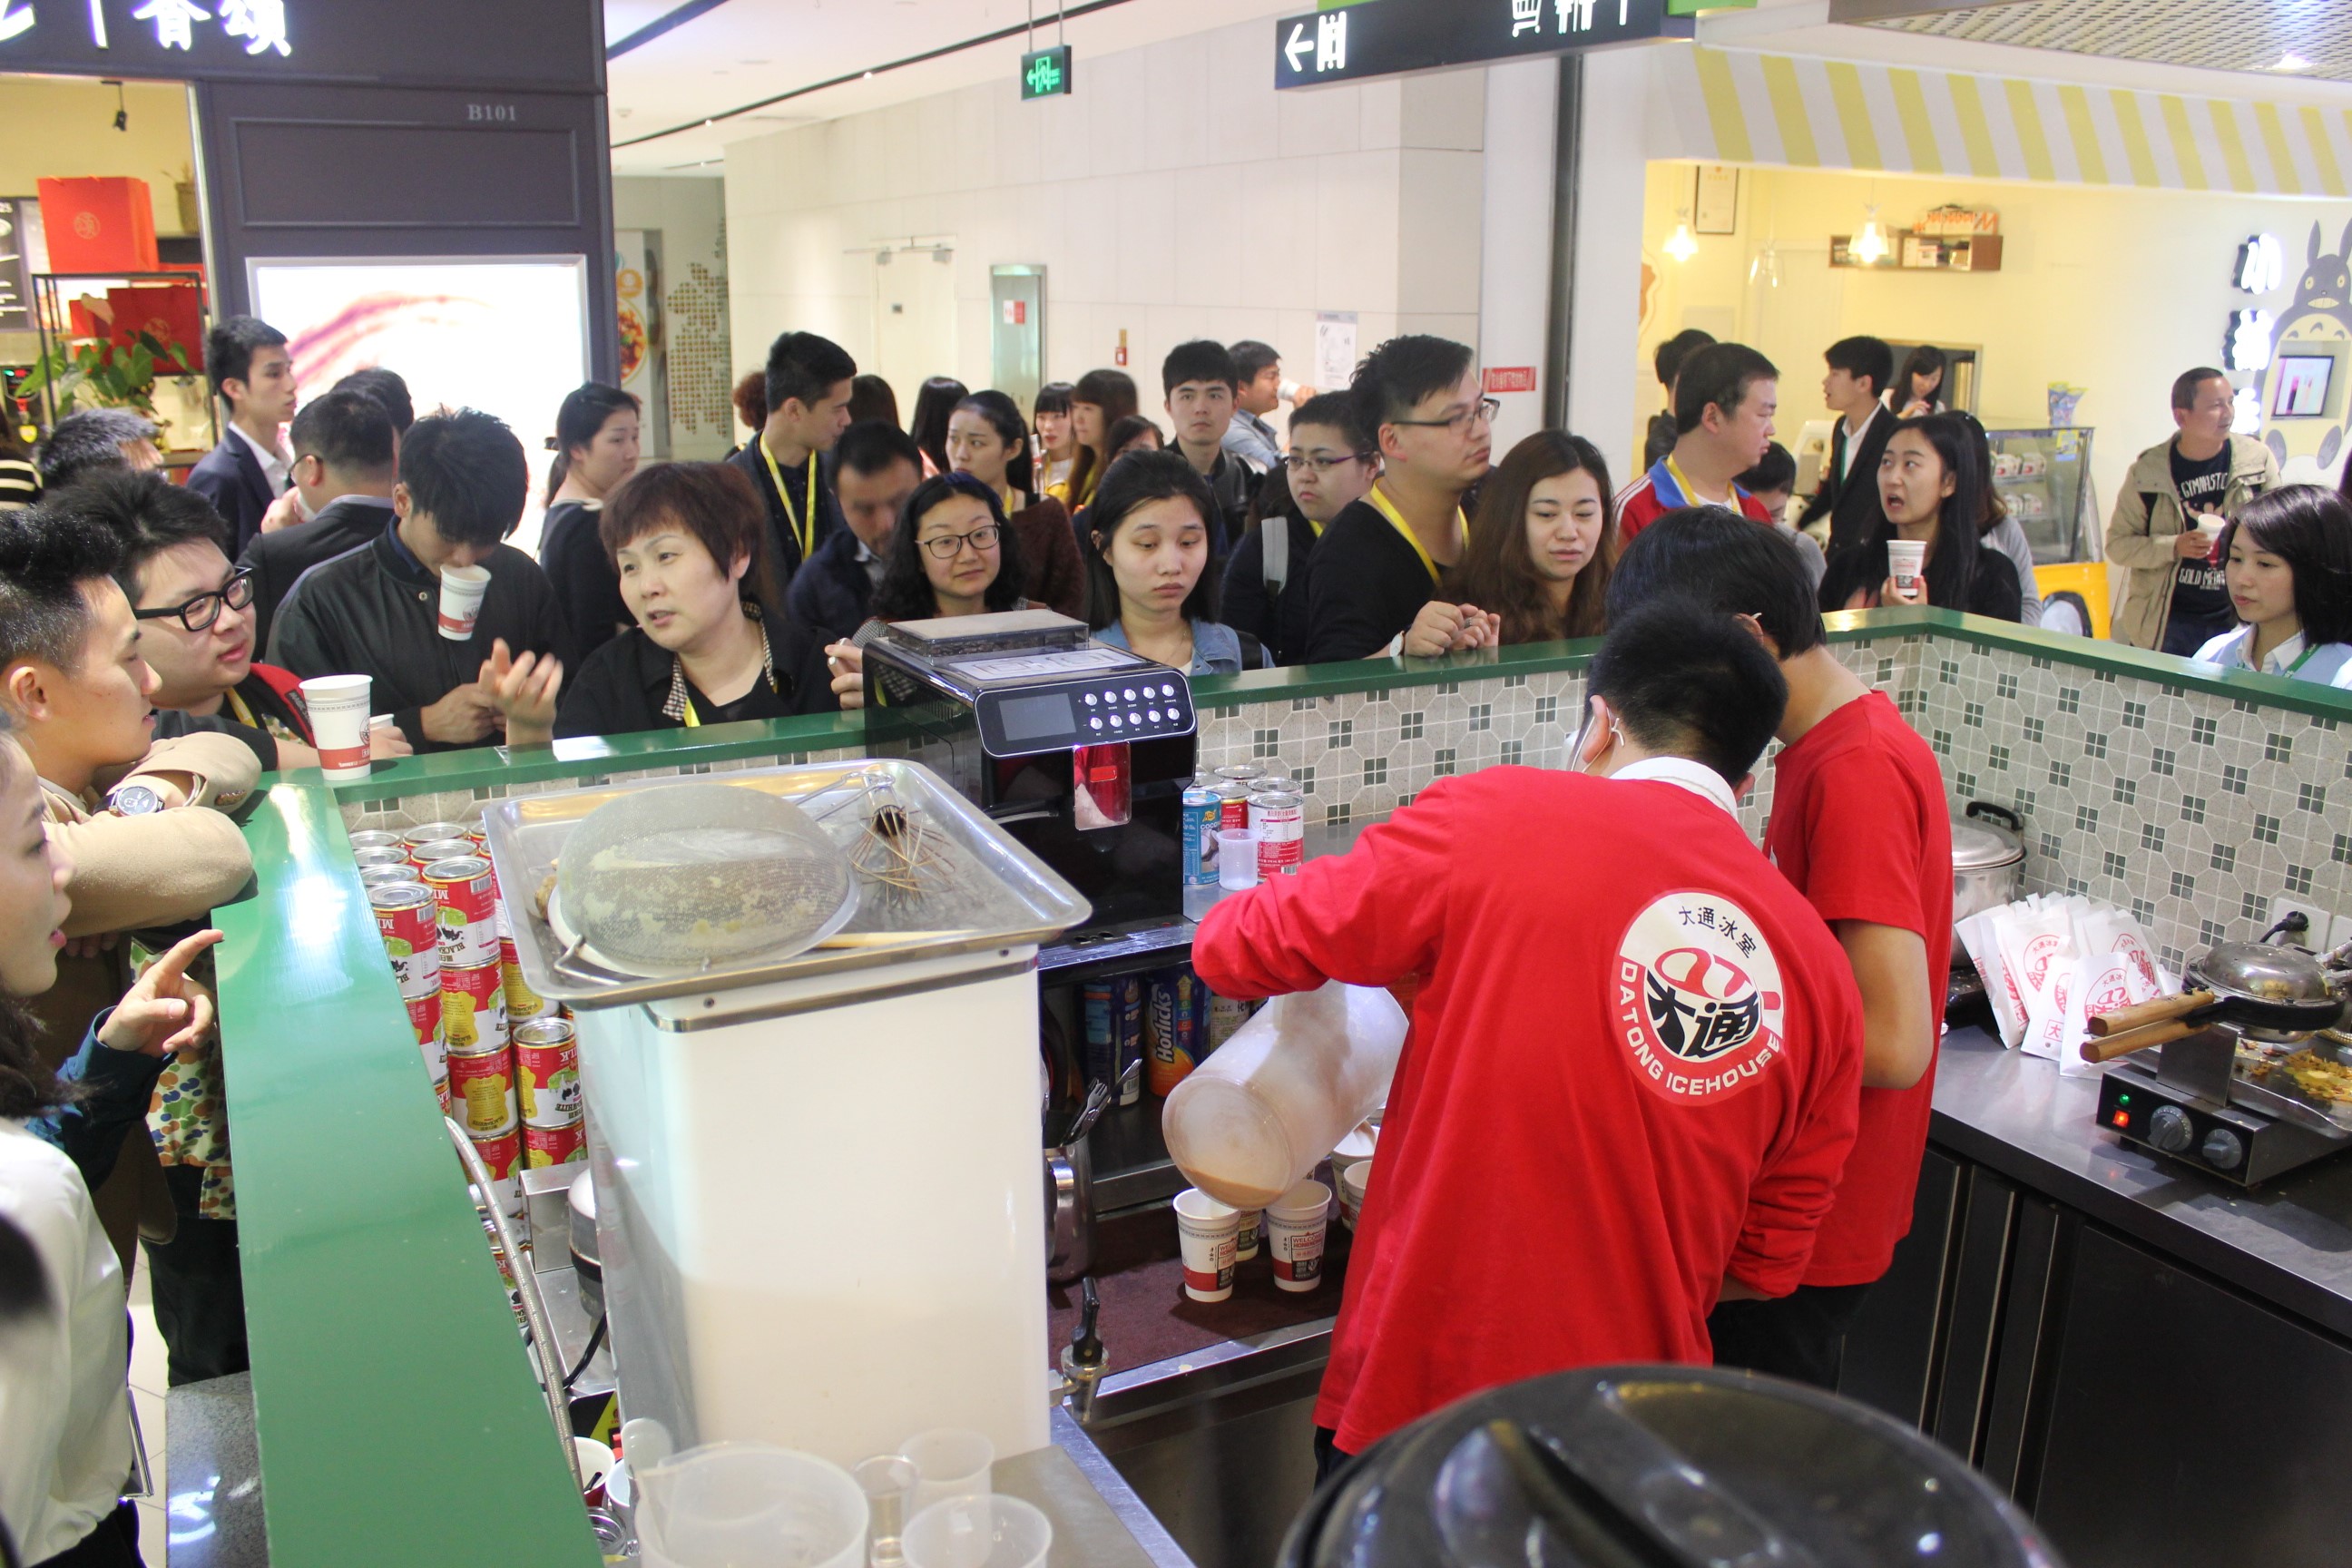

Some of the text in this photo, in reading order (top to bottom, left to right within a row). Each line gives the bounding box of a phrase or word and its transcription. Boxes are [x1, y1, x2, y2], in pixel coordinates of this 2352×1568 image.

[466, 104, 516, 122] B101
[2179, 567, 2201, 585] GOLD
[1679, 906, 1757, 958] 大通冰室
[1154, 989, 1175, 1063] Horlicks
[1620, 961, 1664, 1081] DATONG
[1647, 968, 1759, 1058] 大通
[1666, 1033, 1780, 1096] ICEHOUSE
